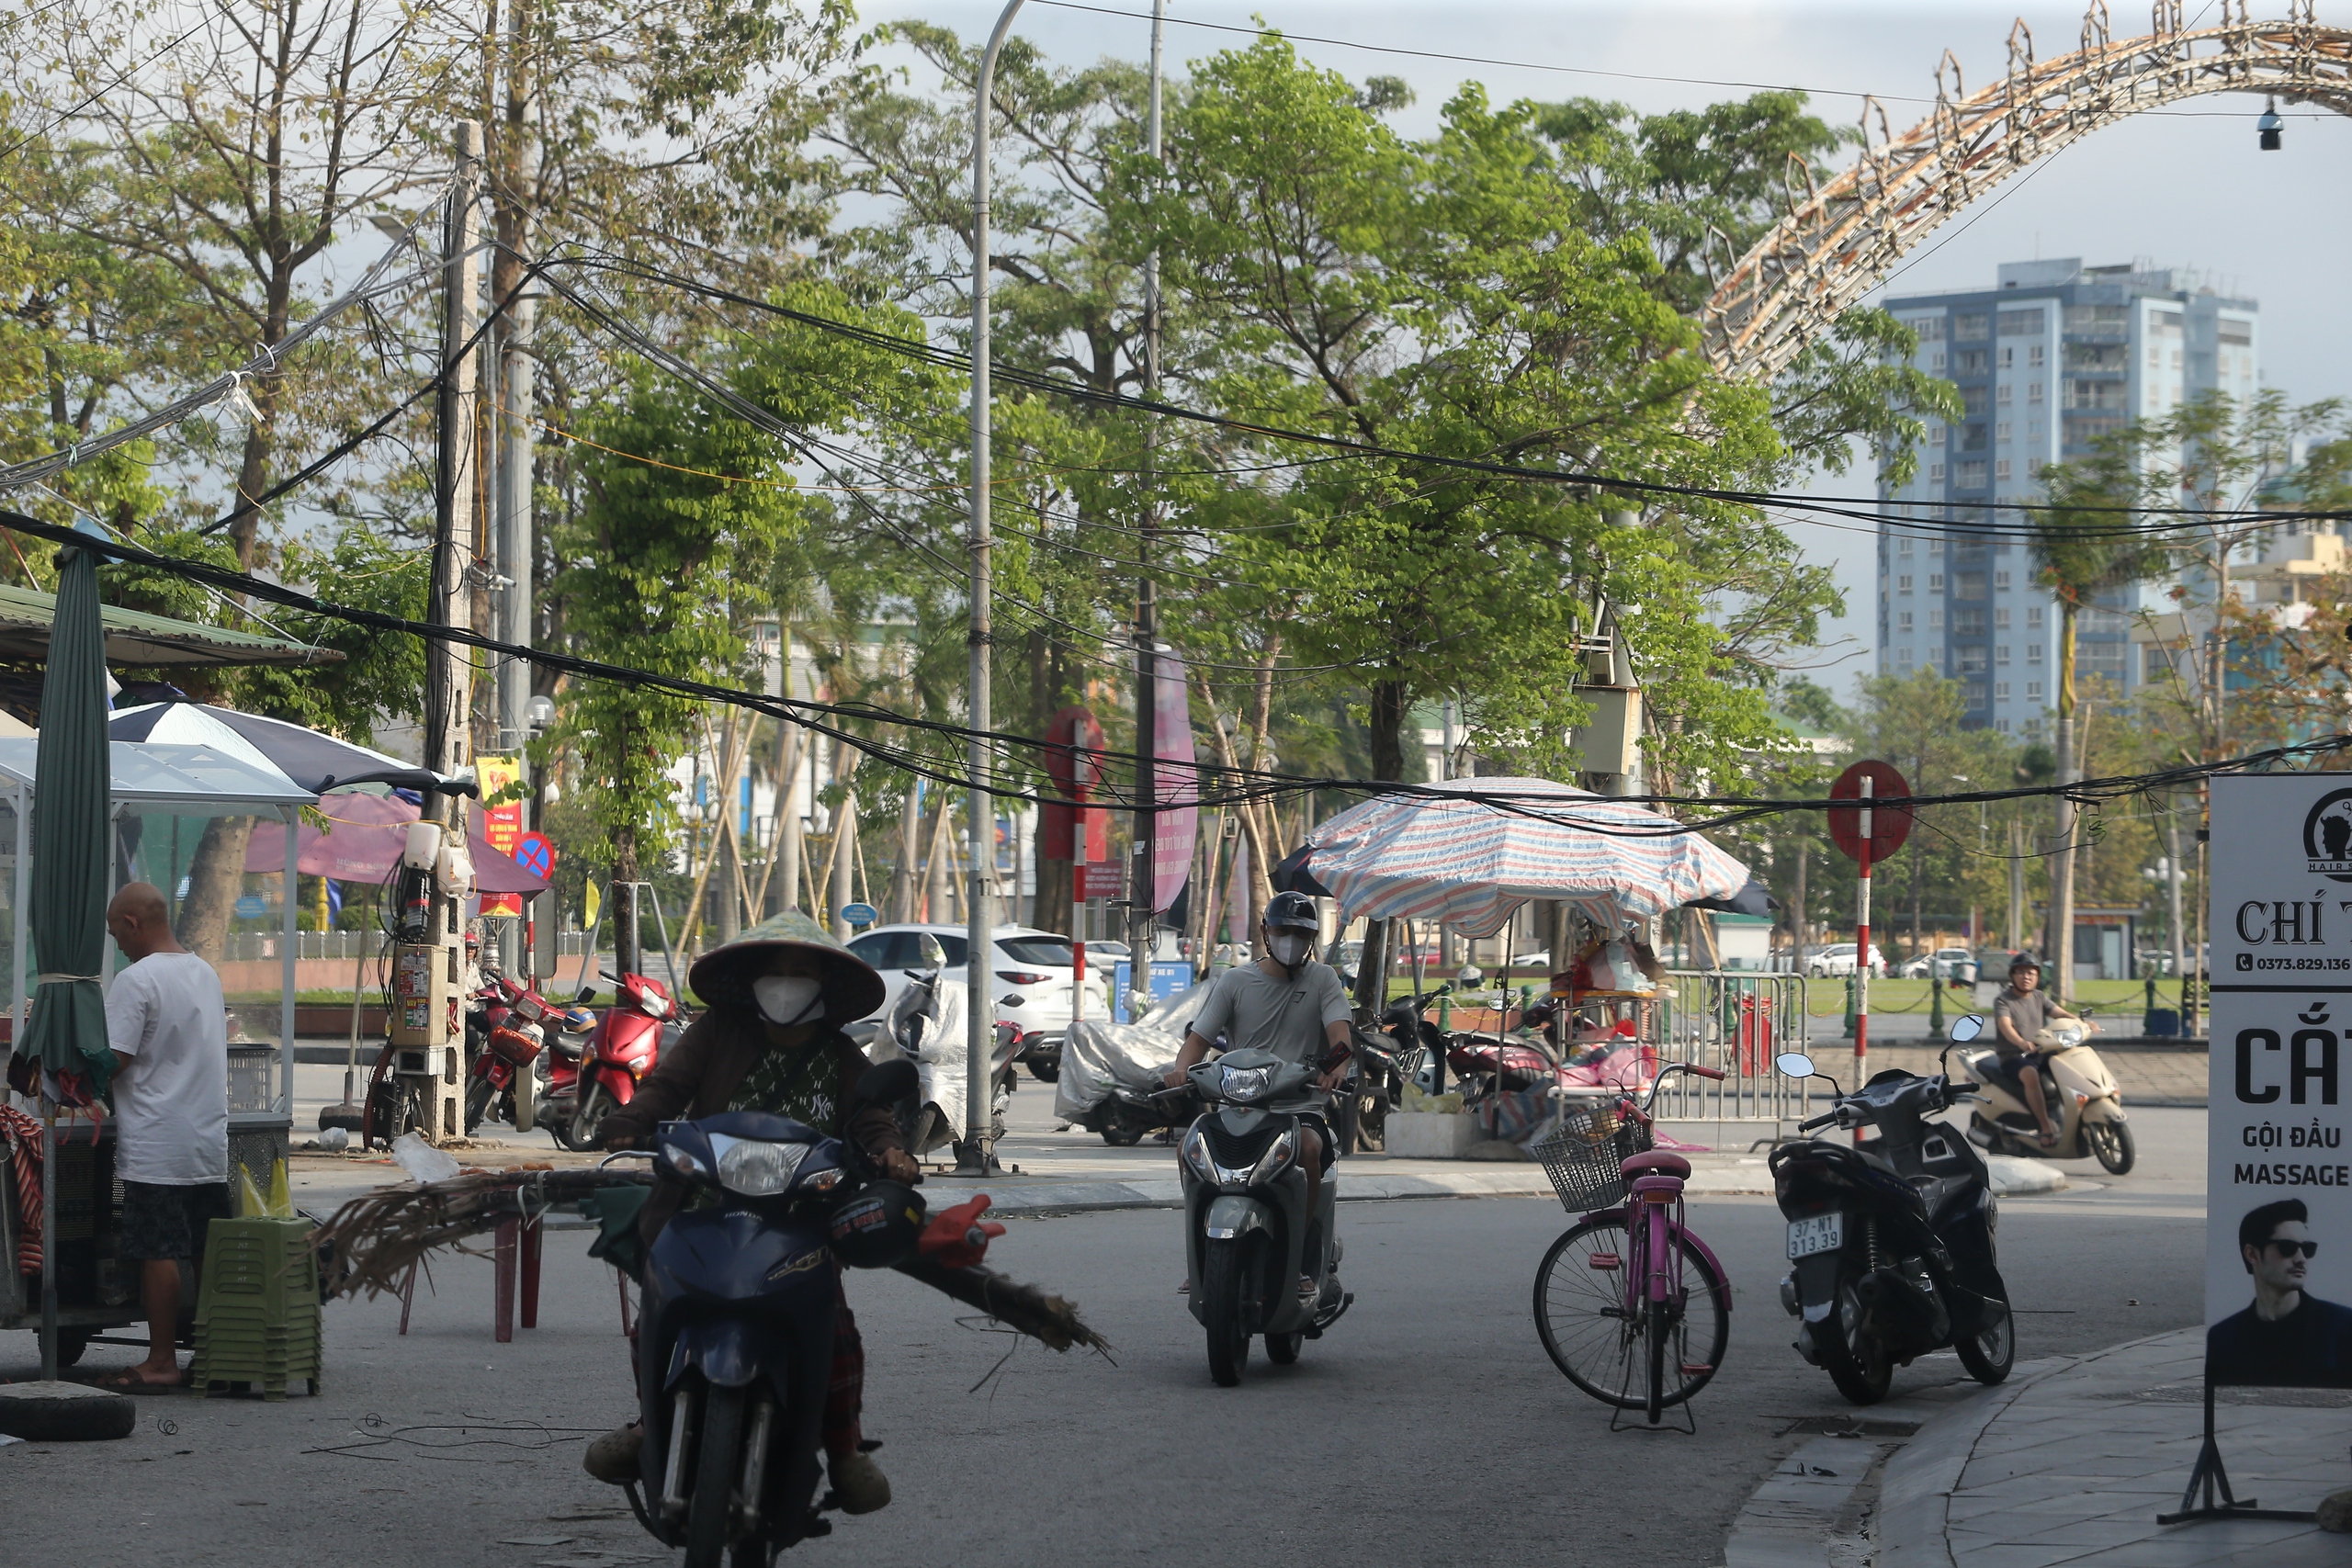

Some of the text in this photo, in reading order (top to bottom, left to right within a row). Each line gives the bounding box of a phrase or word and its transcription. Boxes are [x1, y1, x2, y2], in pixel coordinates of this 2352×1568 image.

[2309, 862, 2343, 872] HAIR
[2236, 889, 2326, 946] CHÍ
[2256, 958, 2350, 971] 0373.829.136
[810, 1093, 830, 1121] NY
[2243, 1117, 2341, 1153] GỘI ĐẦU
[2234, 1164, 2349, 1187] MASSAGE
[724, 1210, 763, 1222] HONDA
[1794, 1215, 1833, 1238] 37-N1
[1790, 1231, 1838, 1257] 313.39
